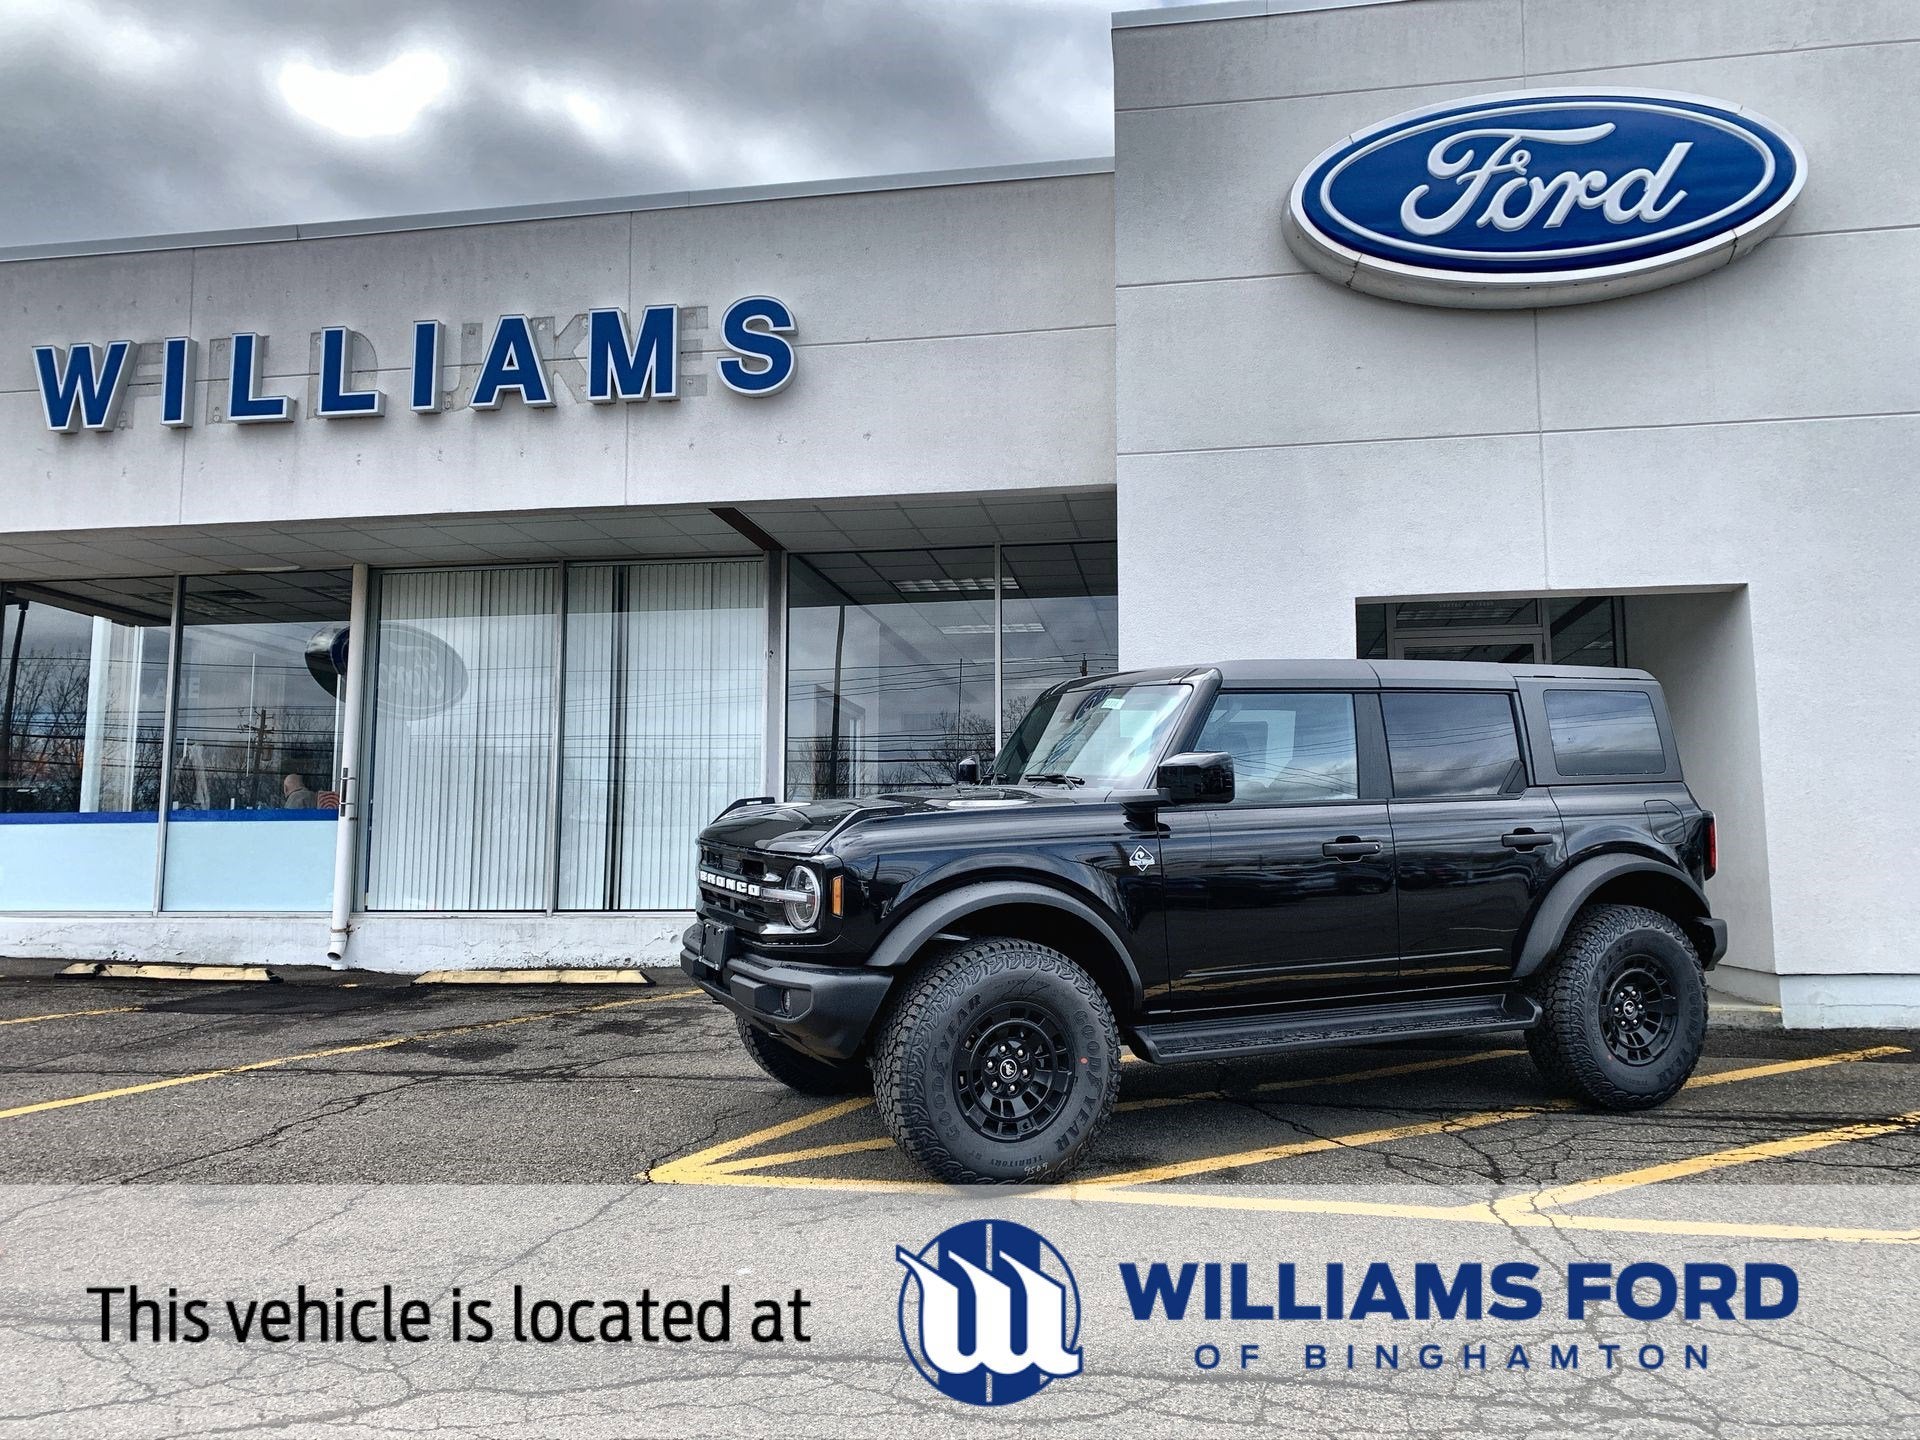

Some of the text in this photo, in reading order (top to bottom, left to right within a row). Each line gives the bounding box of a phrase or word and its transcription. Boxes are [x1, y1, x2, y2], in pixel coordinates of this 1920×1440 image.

[1400, 121, 1694, 237] Ford
[32, 295, 798, 433] WILLIAMS
[700, 869, 760, 897] BRONCO
